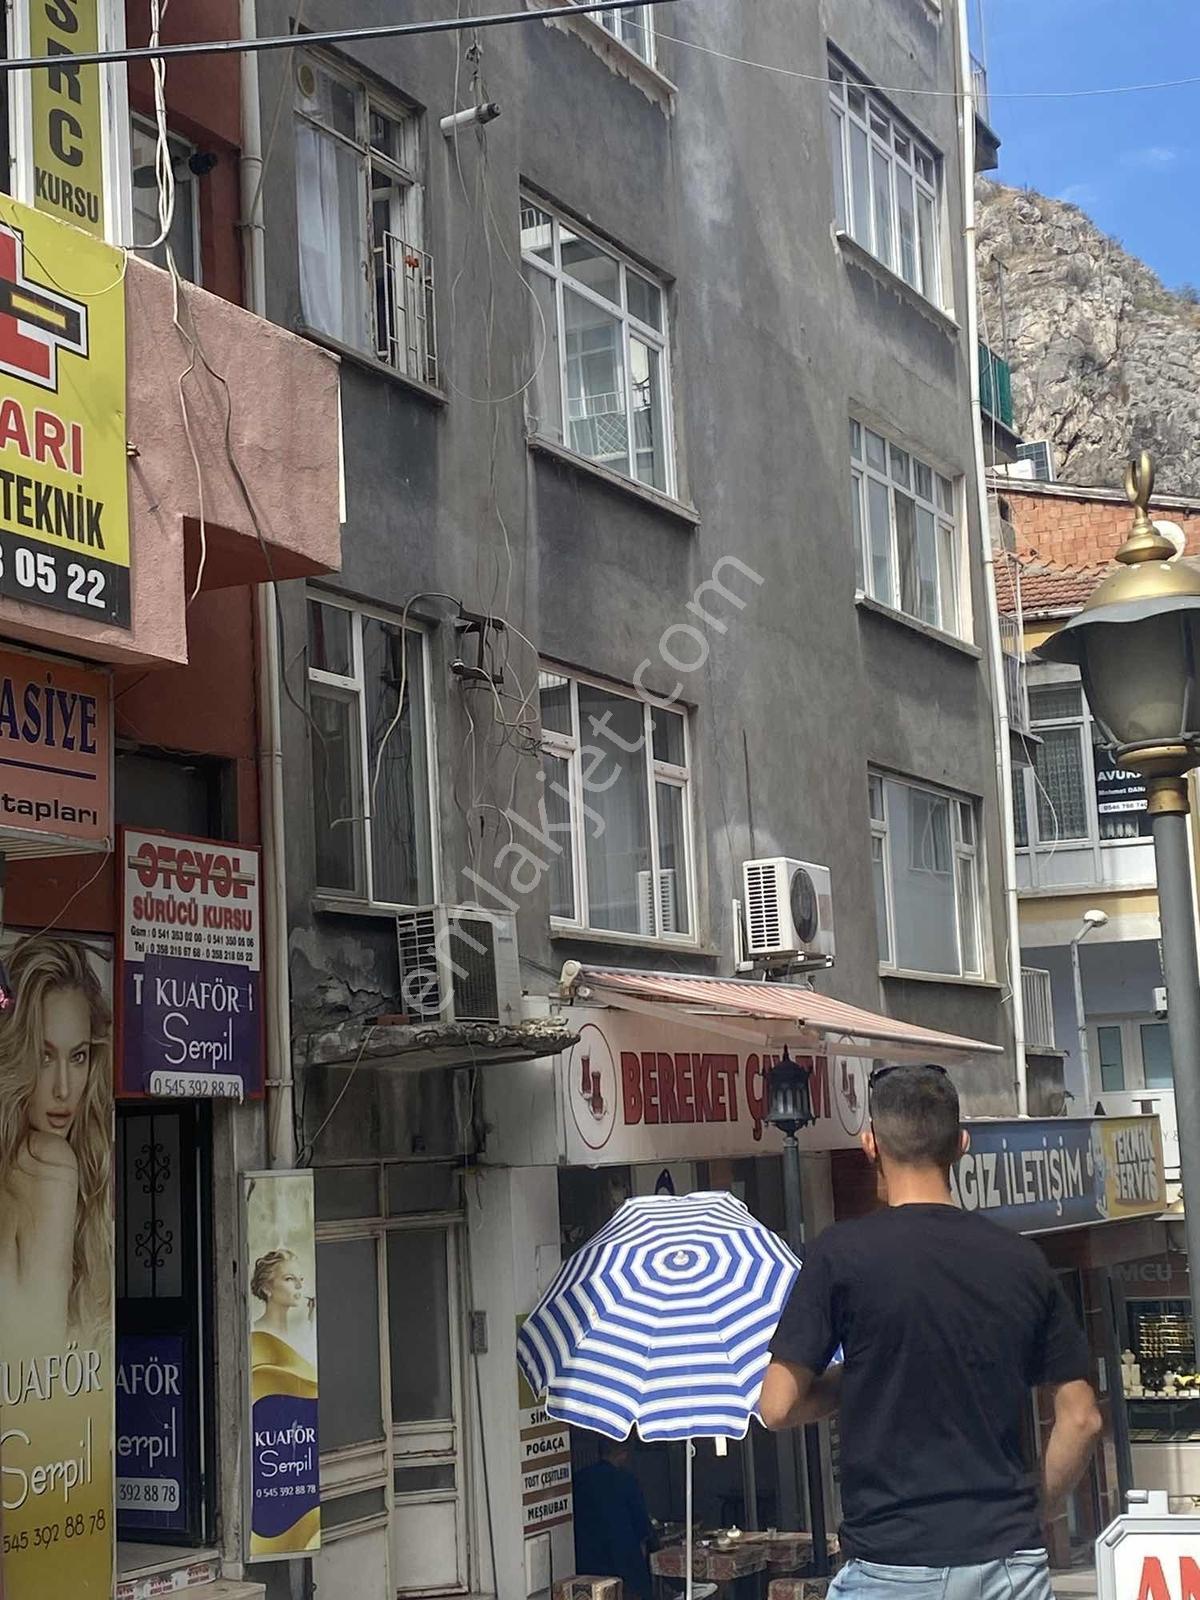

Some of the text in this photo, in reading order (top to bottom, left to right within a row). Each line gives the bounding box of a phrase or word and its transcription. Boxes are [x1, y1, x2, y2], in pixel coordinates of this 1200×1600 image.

[35, 166, 99, 224] KURSU
[0, 469, 105, 550] TEKNİK
[15, 548, 57, 594] 05
[67, 563, 106, 609] 22
[2, 793, 97, 825] tapları
[133, 892, 253, 932] SÜRÜCÜ KURSU
[156, 977, 240, 1013] KUAFÖR
[163, 1012, 233, 1070] Serpil
[154, 1077, 240, 1099] 0 545 392 88 78
[620, 1051, 739, 1126] BEREKET
[1002, 1135, 1084, 1217] İLETİŞİM
[0, 1341, 103, 1408] UAFÖR
[117, 1406, 177, 1468] erpil
[255, 1425, 316, 1447] KUAFÖR
[0, 1416, 93, 1510] Serpil
[260, 1446, 312, 1477] Serpil
[119, 1484, 177, 1503] 392 88 78
[256, 1488, 262, 1498] 0
[527, 1498, 569, 1521] MEŞRUBAT
[3, 1508, 106, 1553] 545 392 88 78
